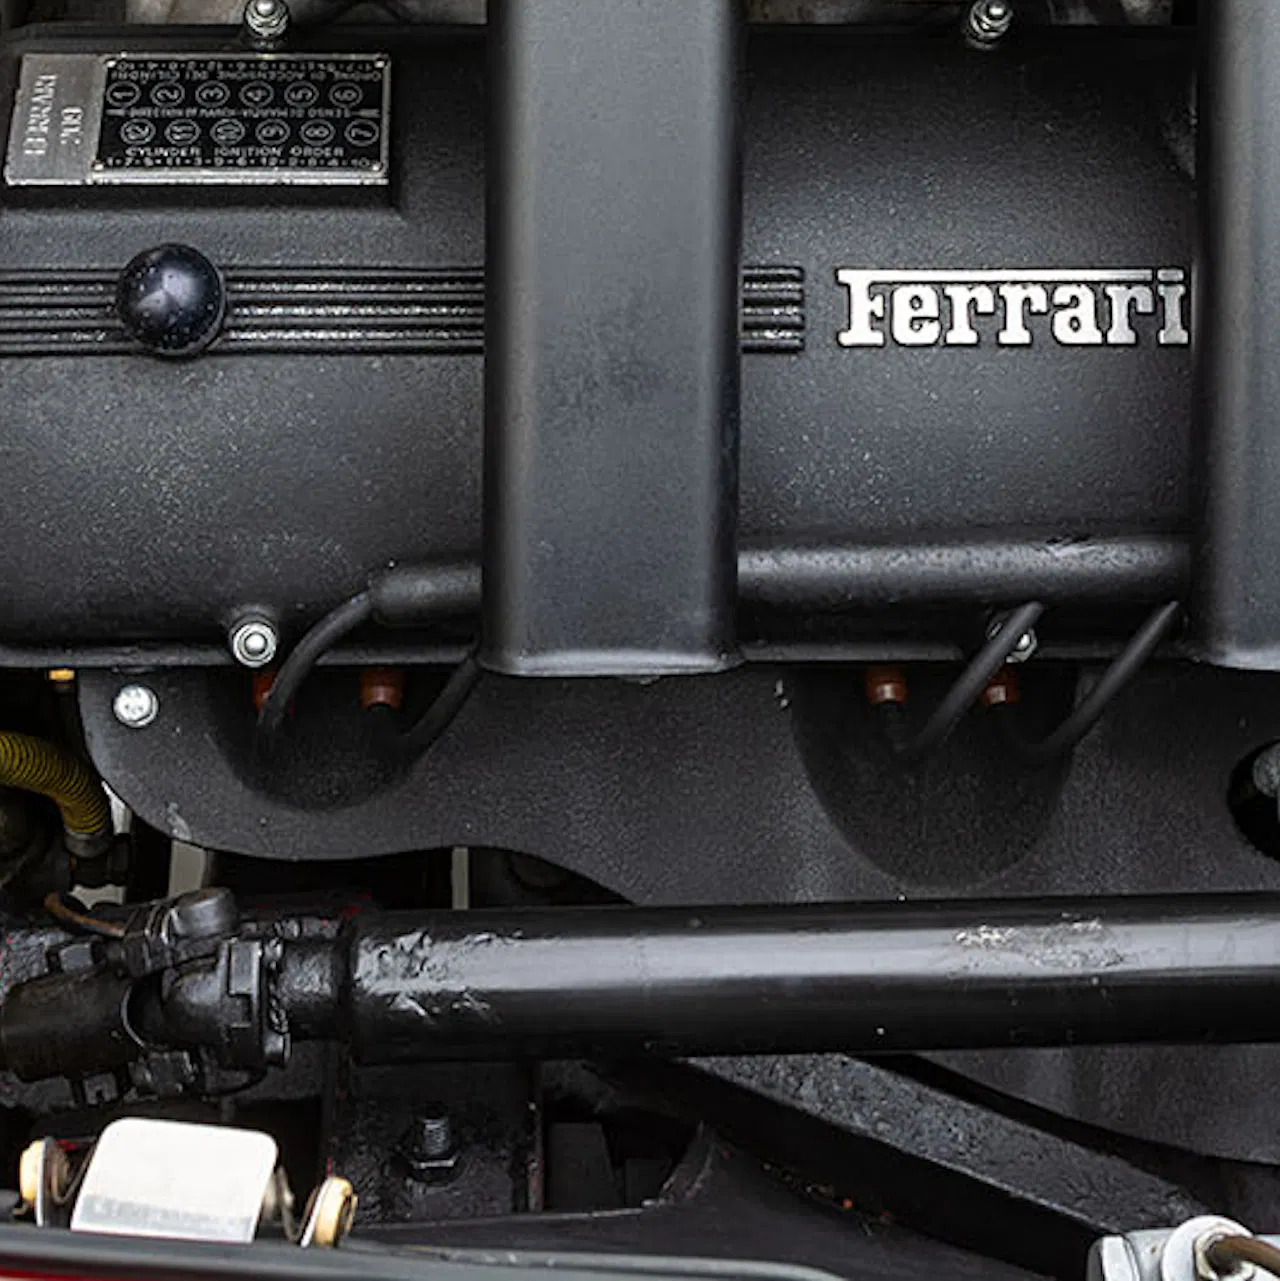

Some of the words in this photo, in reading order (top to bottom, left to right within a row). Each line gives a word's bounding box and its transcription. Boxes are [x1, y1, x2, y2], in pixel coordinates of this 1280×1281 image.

[126, 146, 201, 157] CYLINDER
[214, 146, 283, 157] IGNITION
[290, 146, 345, 157] ORDER
[836, 268, 1190, 347] Ferrari
